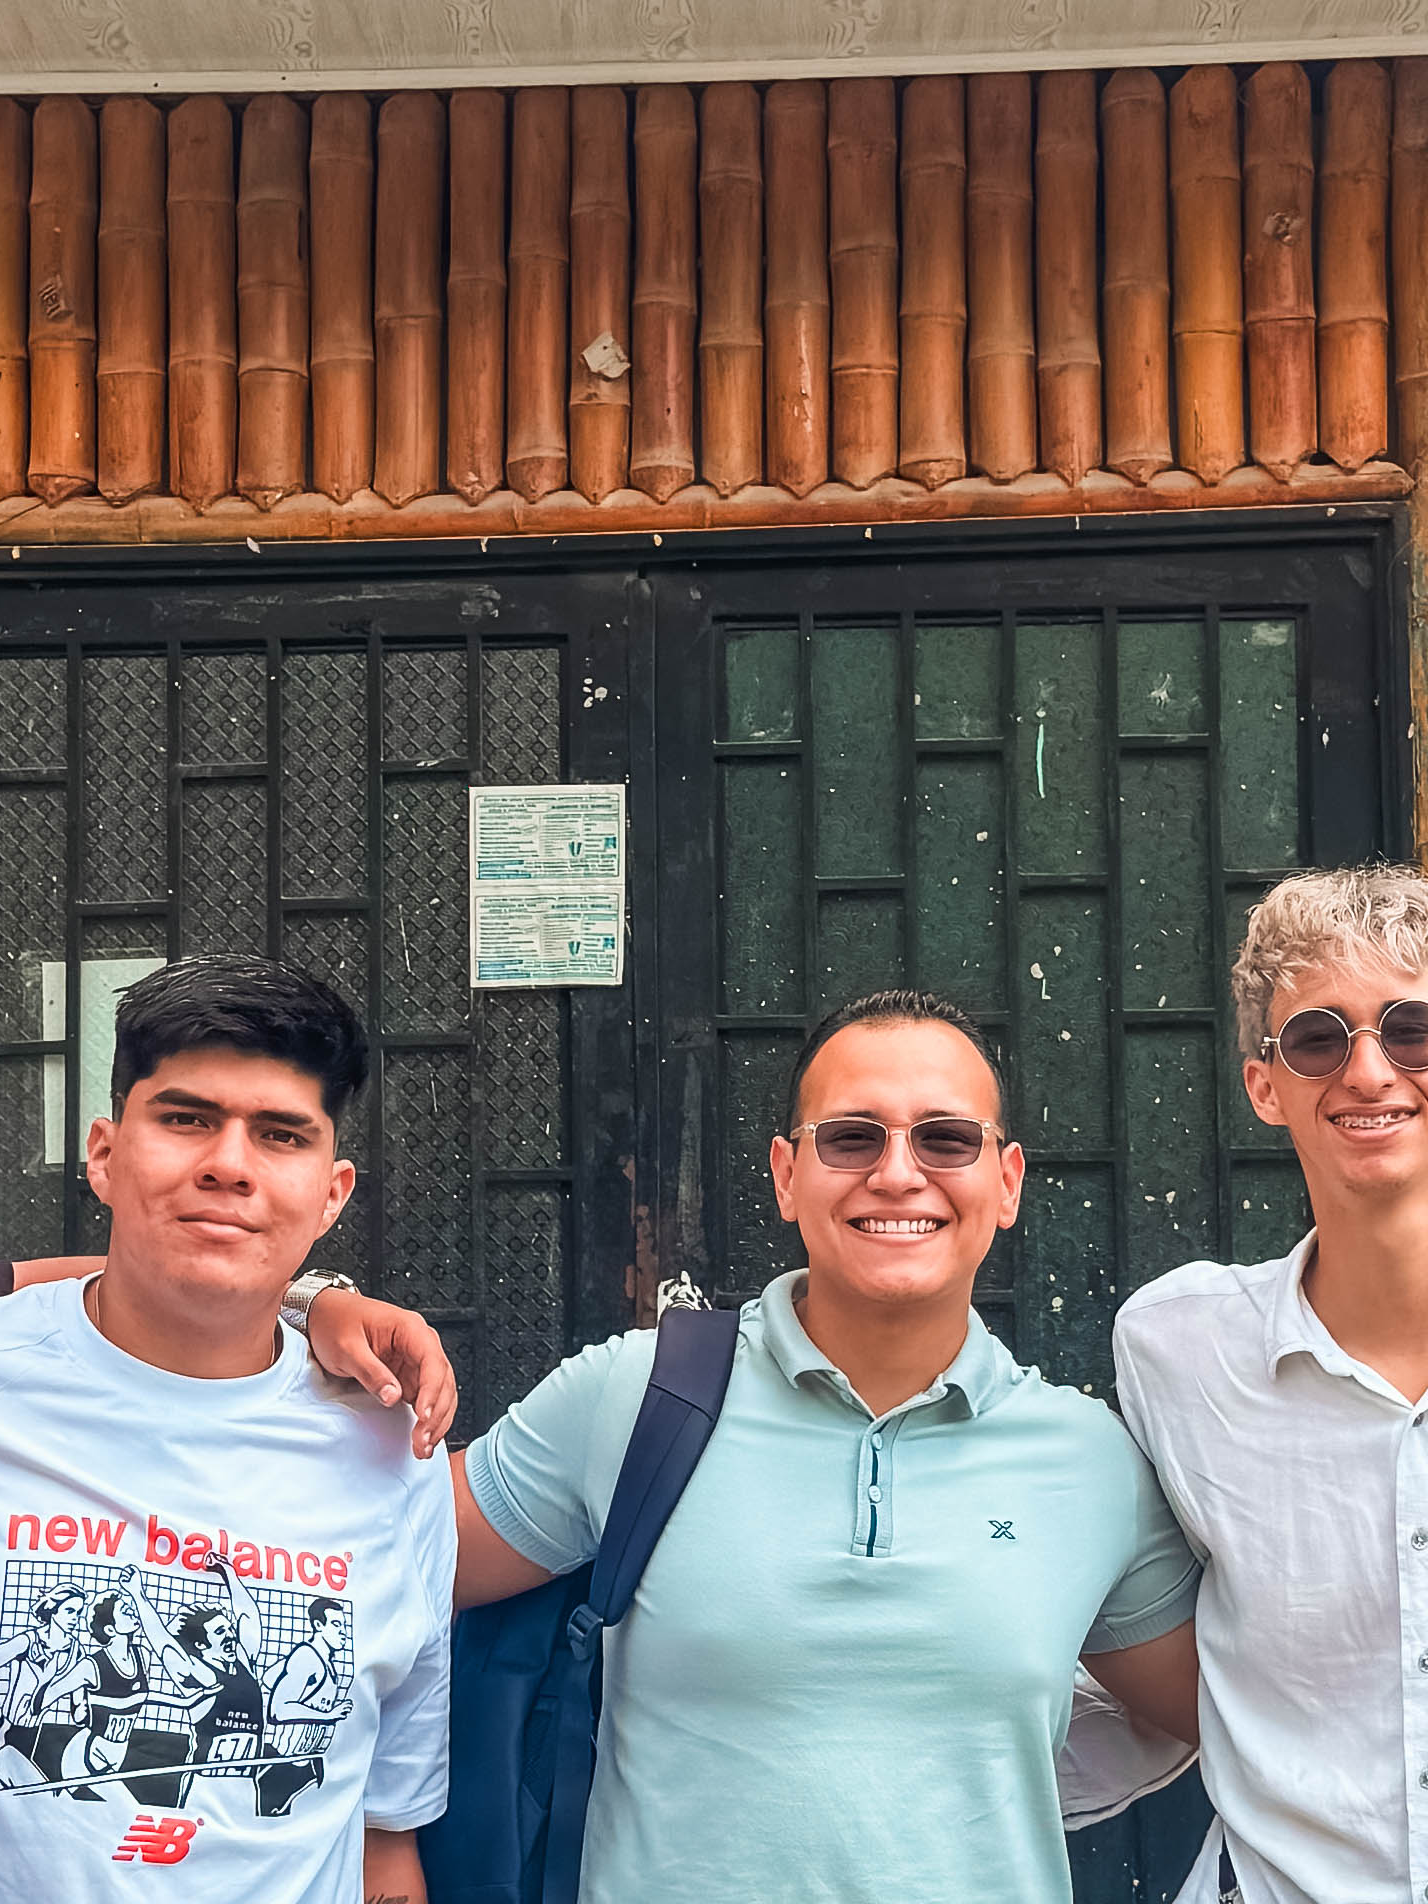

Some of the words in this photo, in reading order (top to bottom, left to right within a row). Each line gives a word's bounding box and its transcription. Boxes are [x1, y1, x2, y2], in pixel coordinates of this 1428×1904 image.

[8, 1514, 128, 1557] new
[144, 1514, 349, 1591] balance
[215, 1717, 259, 1730] balance
[227, 1711, 249, 1719] new
[112, 1815, 197, 1866] NB
